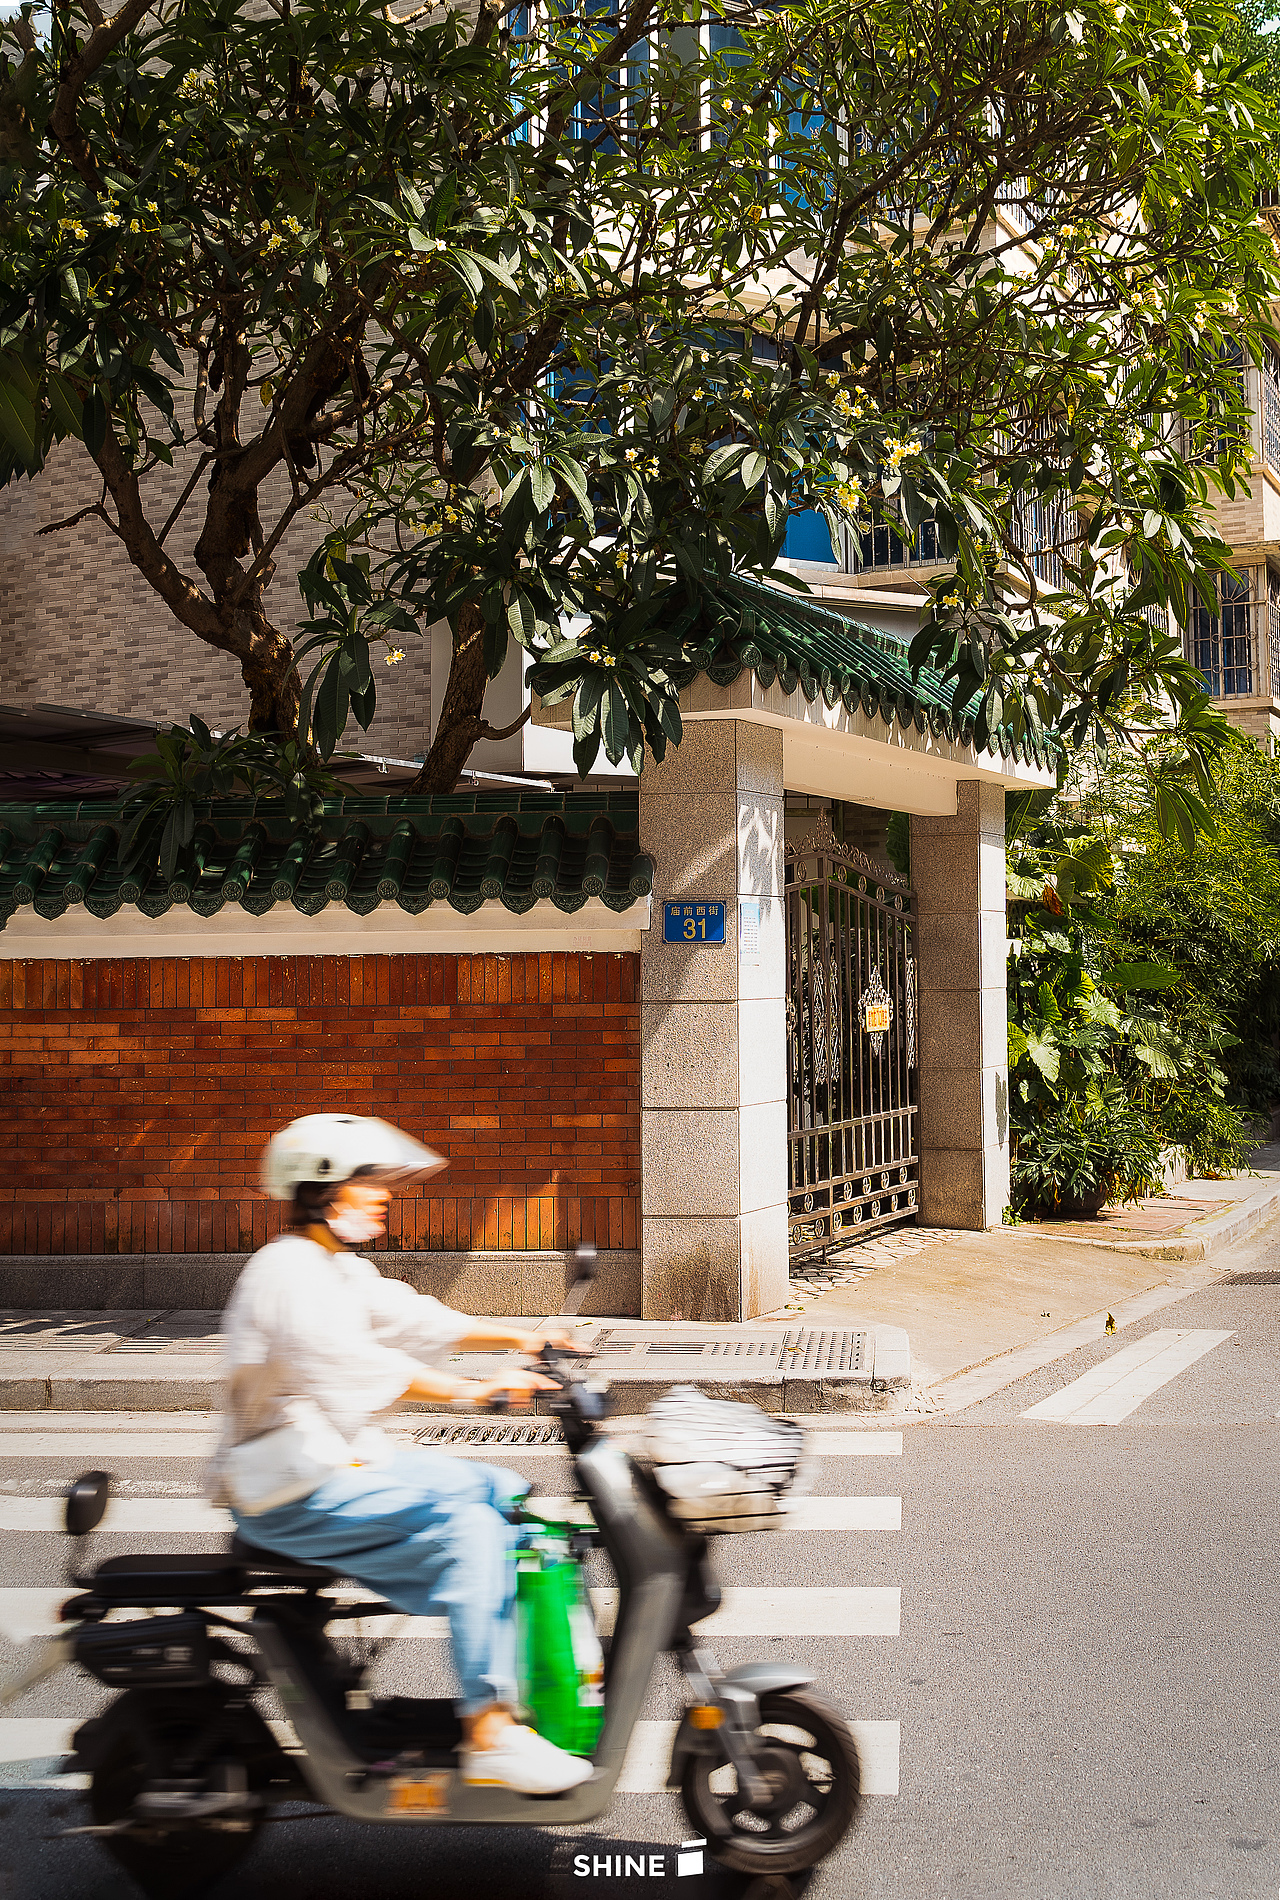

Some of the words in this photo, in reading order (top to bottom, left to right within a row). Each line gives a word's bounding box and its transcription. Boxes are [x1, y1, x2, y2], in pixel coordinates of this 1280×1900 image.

[670, 906, 719, 916] 庙前西街
[683, 918, 706, 939] 31
